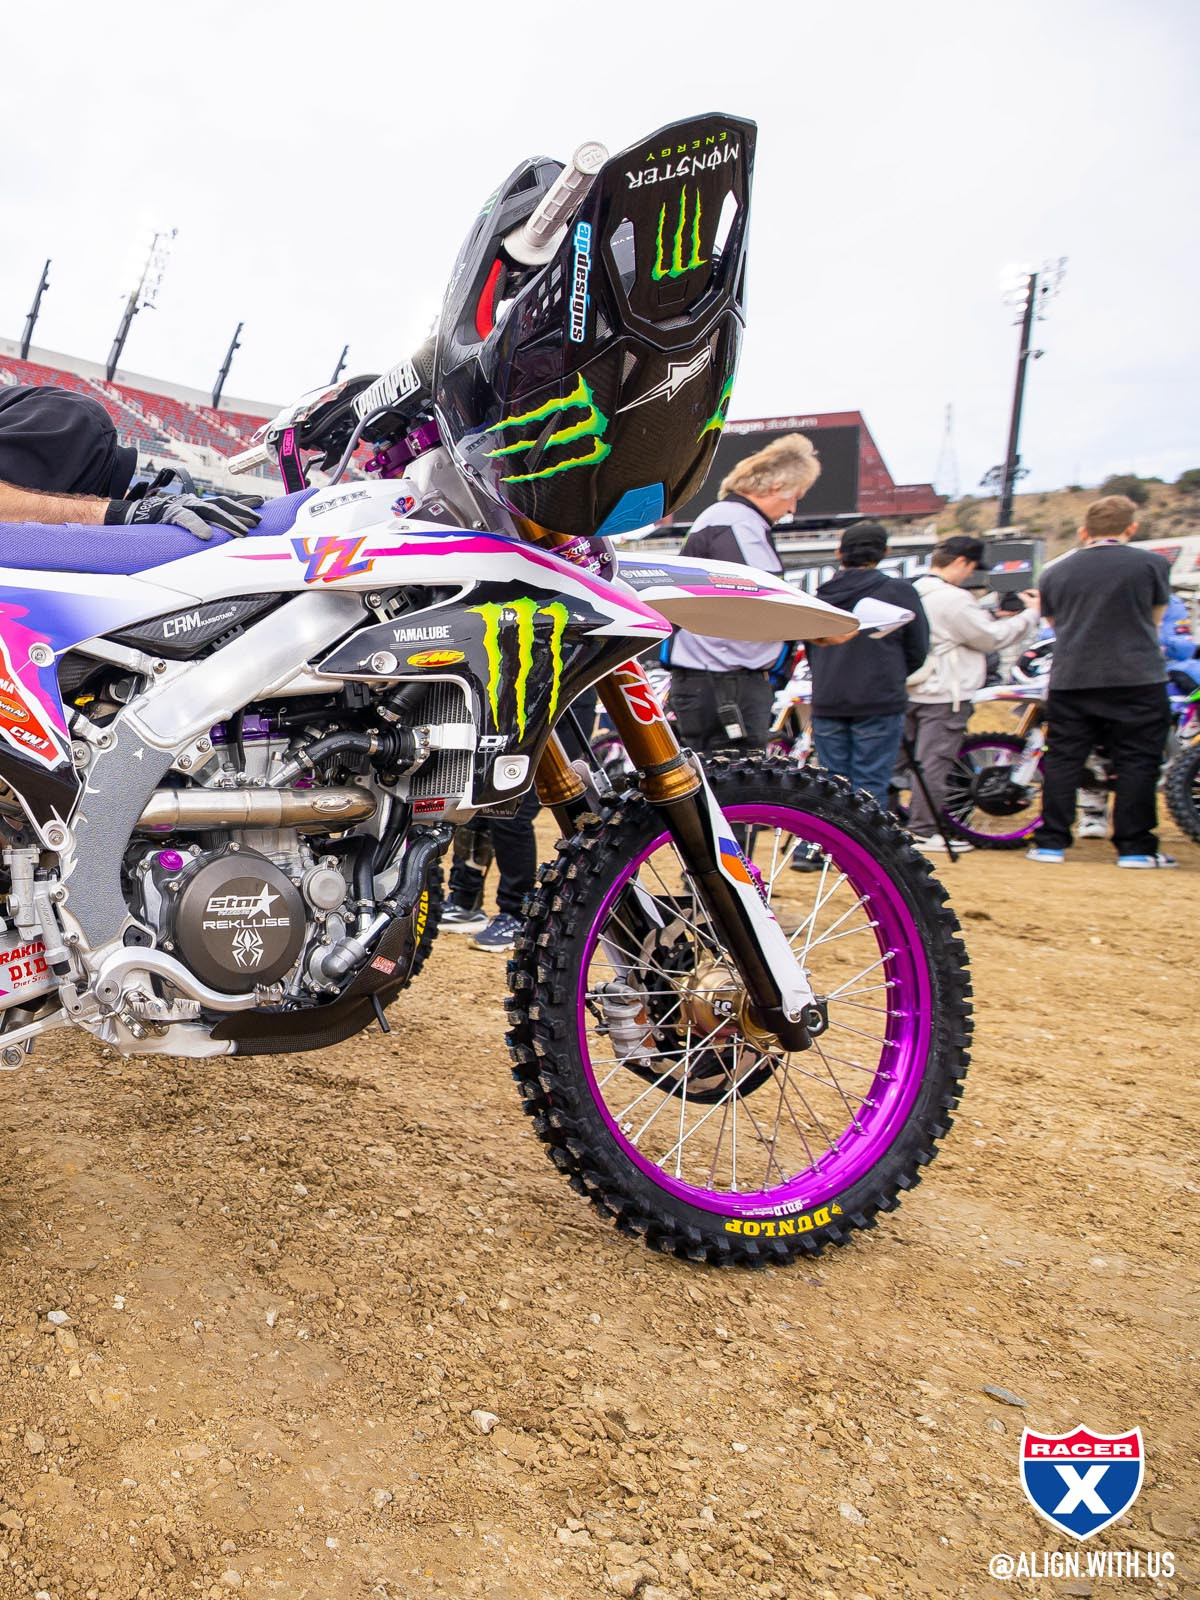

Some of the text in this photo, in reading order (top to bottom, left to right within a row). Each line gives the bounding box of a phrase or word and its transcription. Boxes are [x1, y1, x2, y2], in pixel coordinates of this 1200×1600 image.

[646, 131, 728, 162] ENERGY
[625, 142, 740, 190] MONSTER
[569, 221, 592, 343] apdesigns
[357, 361, 417, 418] PROTAPER
[290, 535, 376, 584] YZ
[162, 608, 202, 639] CRM
[392, 625, 451, 642] YAMALUBE
[202, 917, 290, 930] REKLUSE
[8, 956, 49, 982] D.I.D
[724, 1206, 832, 1237] DUNLOP
